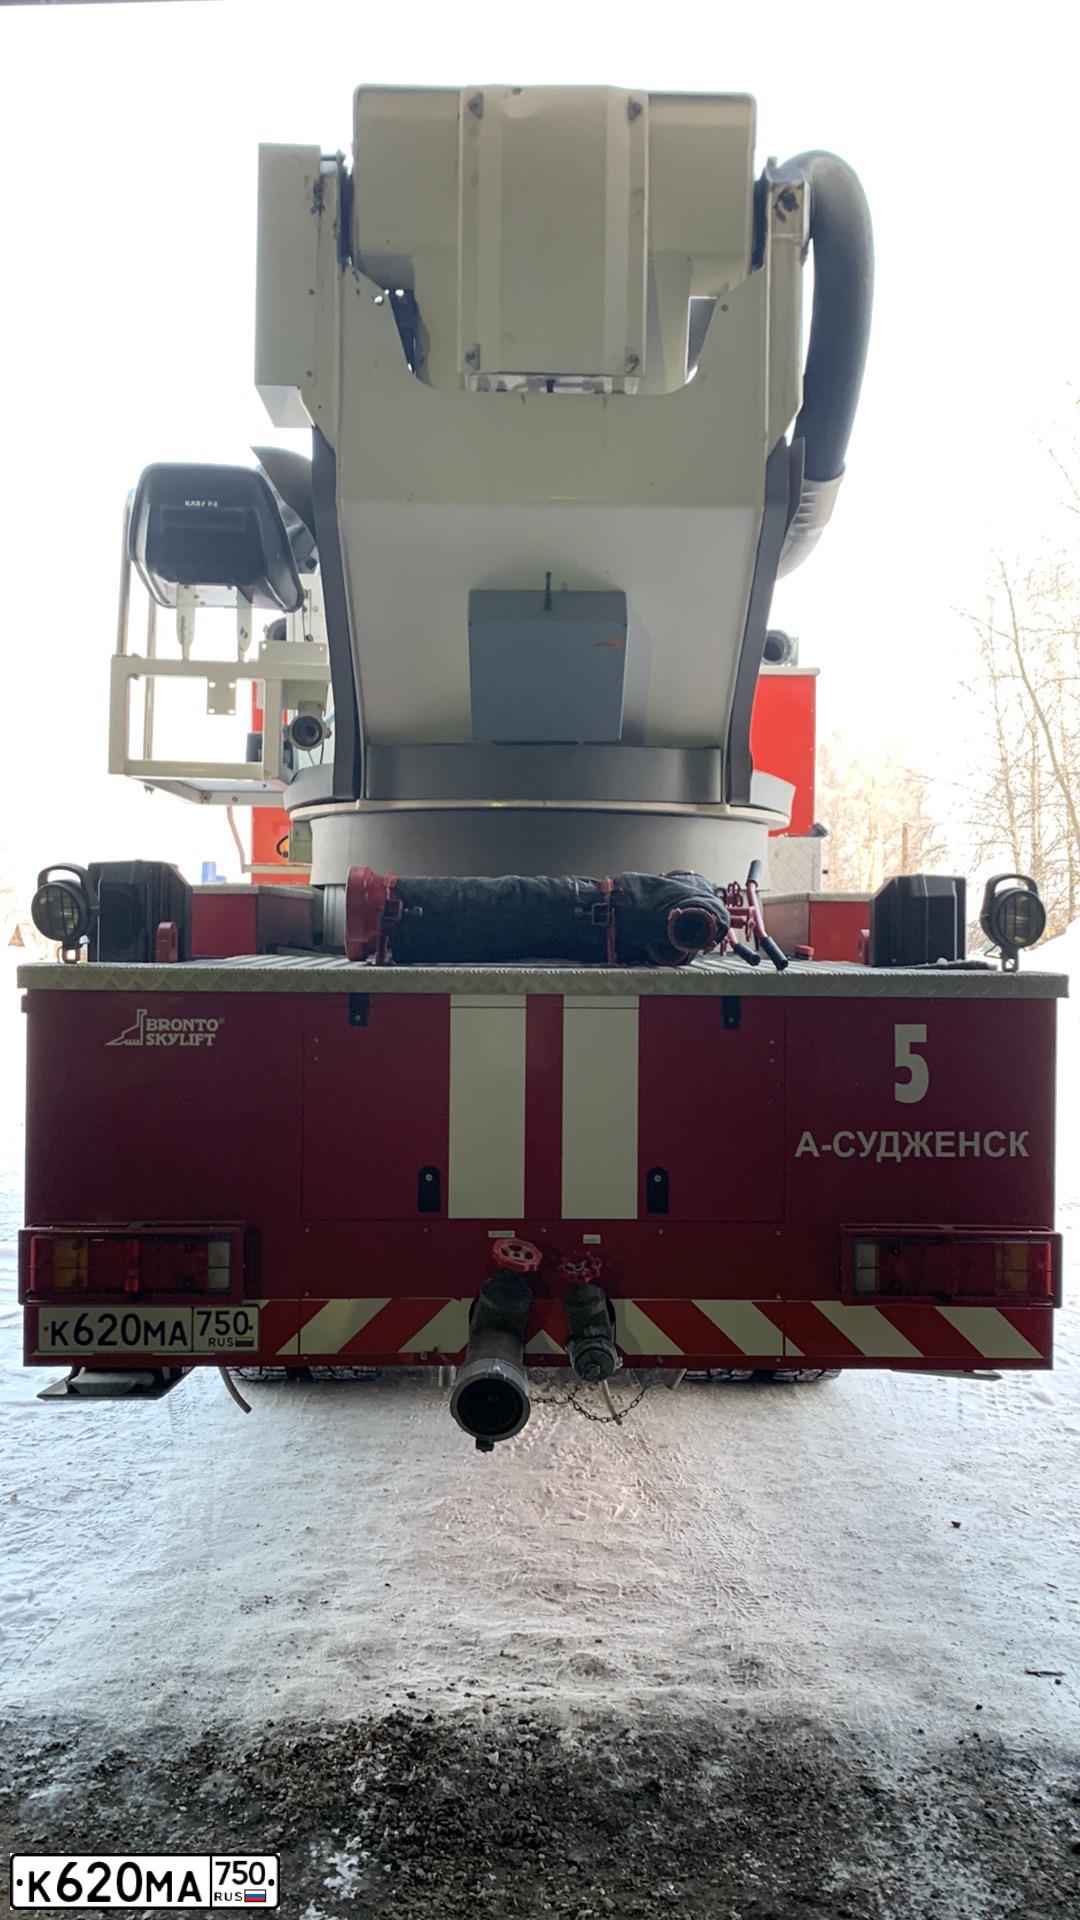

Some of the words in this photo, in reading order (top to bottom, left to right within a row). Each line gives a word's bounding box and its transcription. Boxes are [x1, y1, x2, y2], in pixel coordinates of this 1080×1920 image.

[146, 1033, 215, 1046] SKYLIFT
[894, 1024, 930, 1104] 5
[794, 1131, 1029, 1163] А-СУДЖЕНСК
[51, 1313, 188, 1346] К620МА
[196, 1311, 249, 1336] 750
[208, 1337, 234, 1347] RUS
